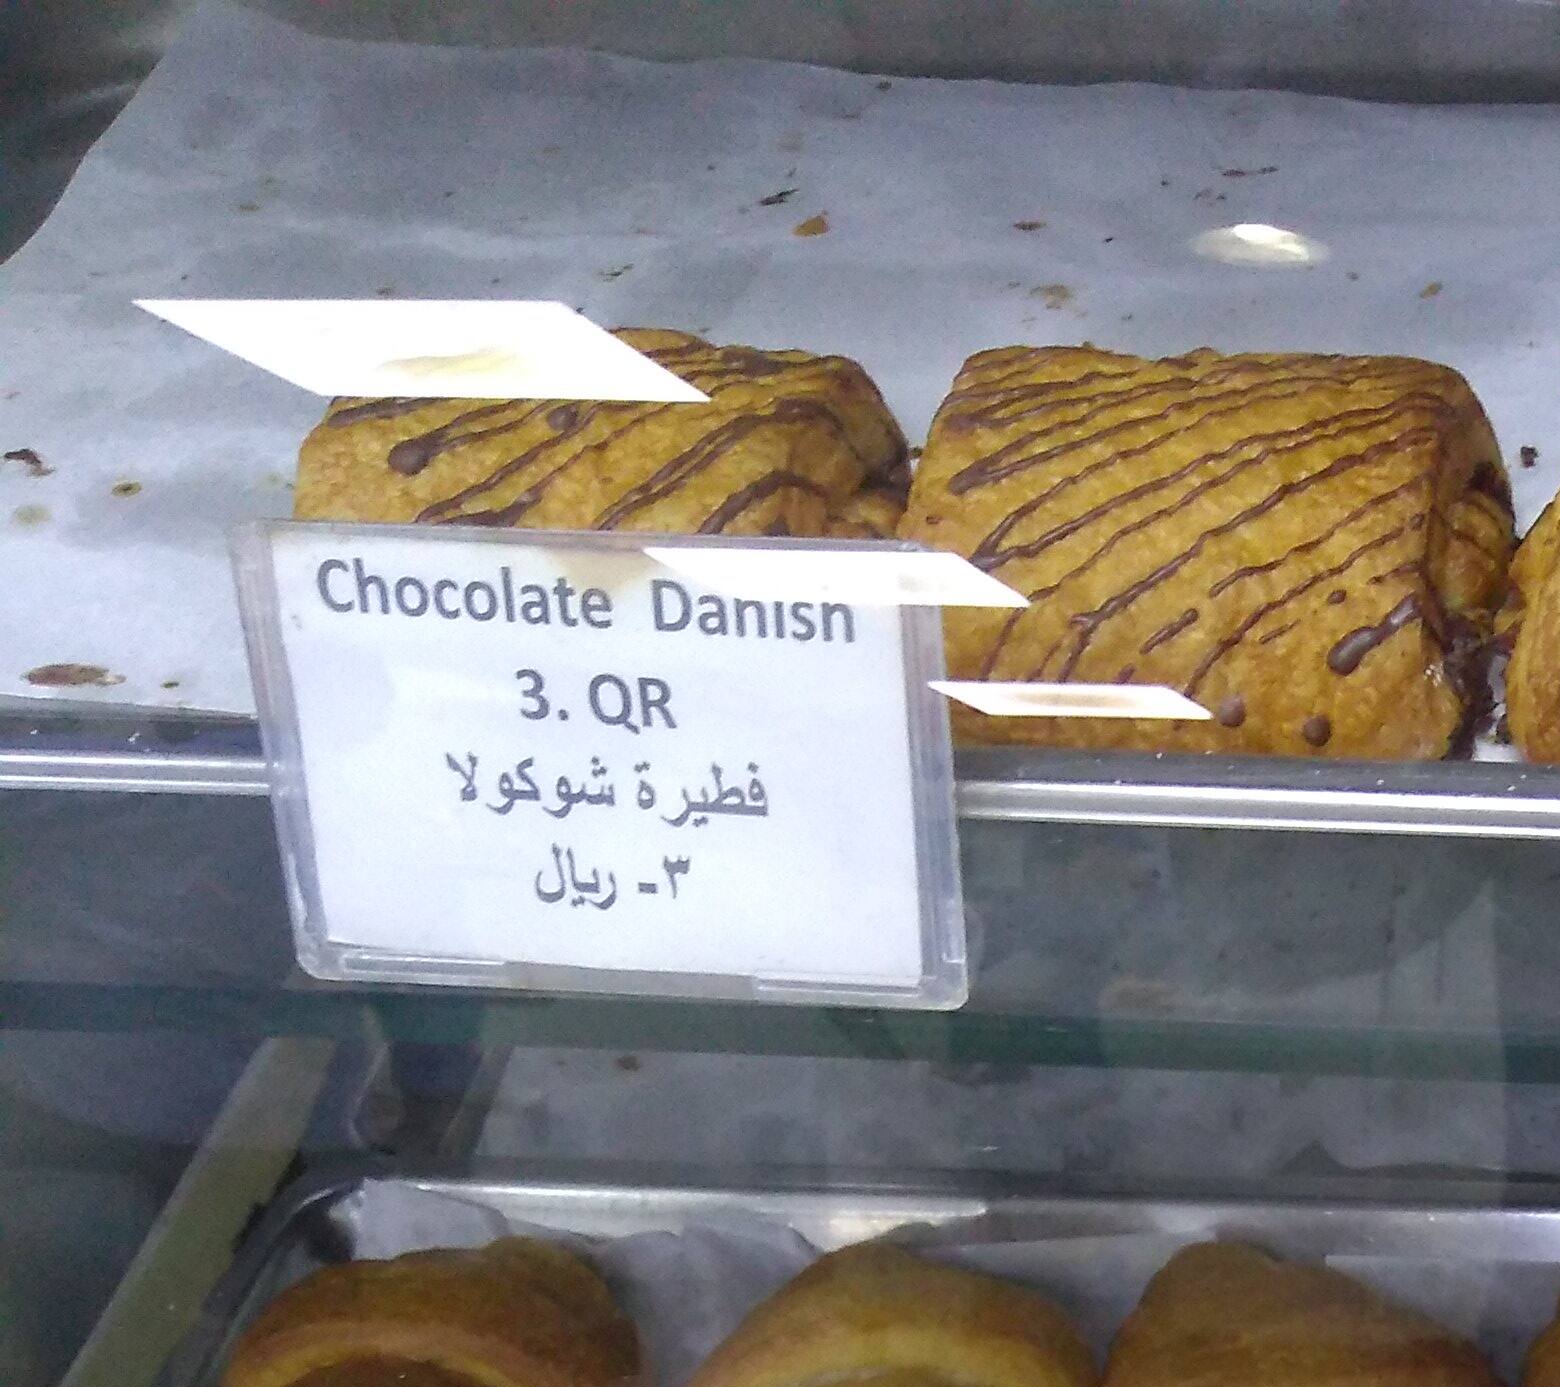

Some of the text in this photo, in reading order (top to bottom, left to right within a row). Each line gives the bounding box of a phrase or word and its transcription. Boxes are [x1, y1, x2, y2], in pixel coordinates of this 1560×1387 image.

[316, 556, 614, 630] Chocolate
[514, 667, 679, 735] 3. QR
[444, 751, 770, 827] فطيرة شوكولا
[534, 842, 618, 911] ريال
